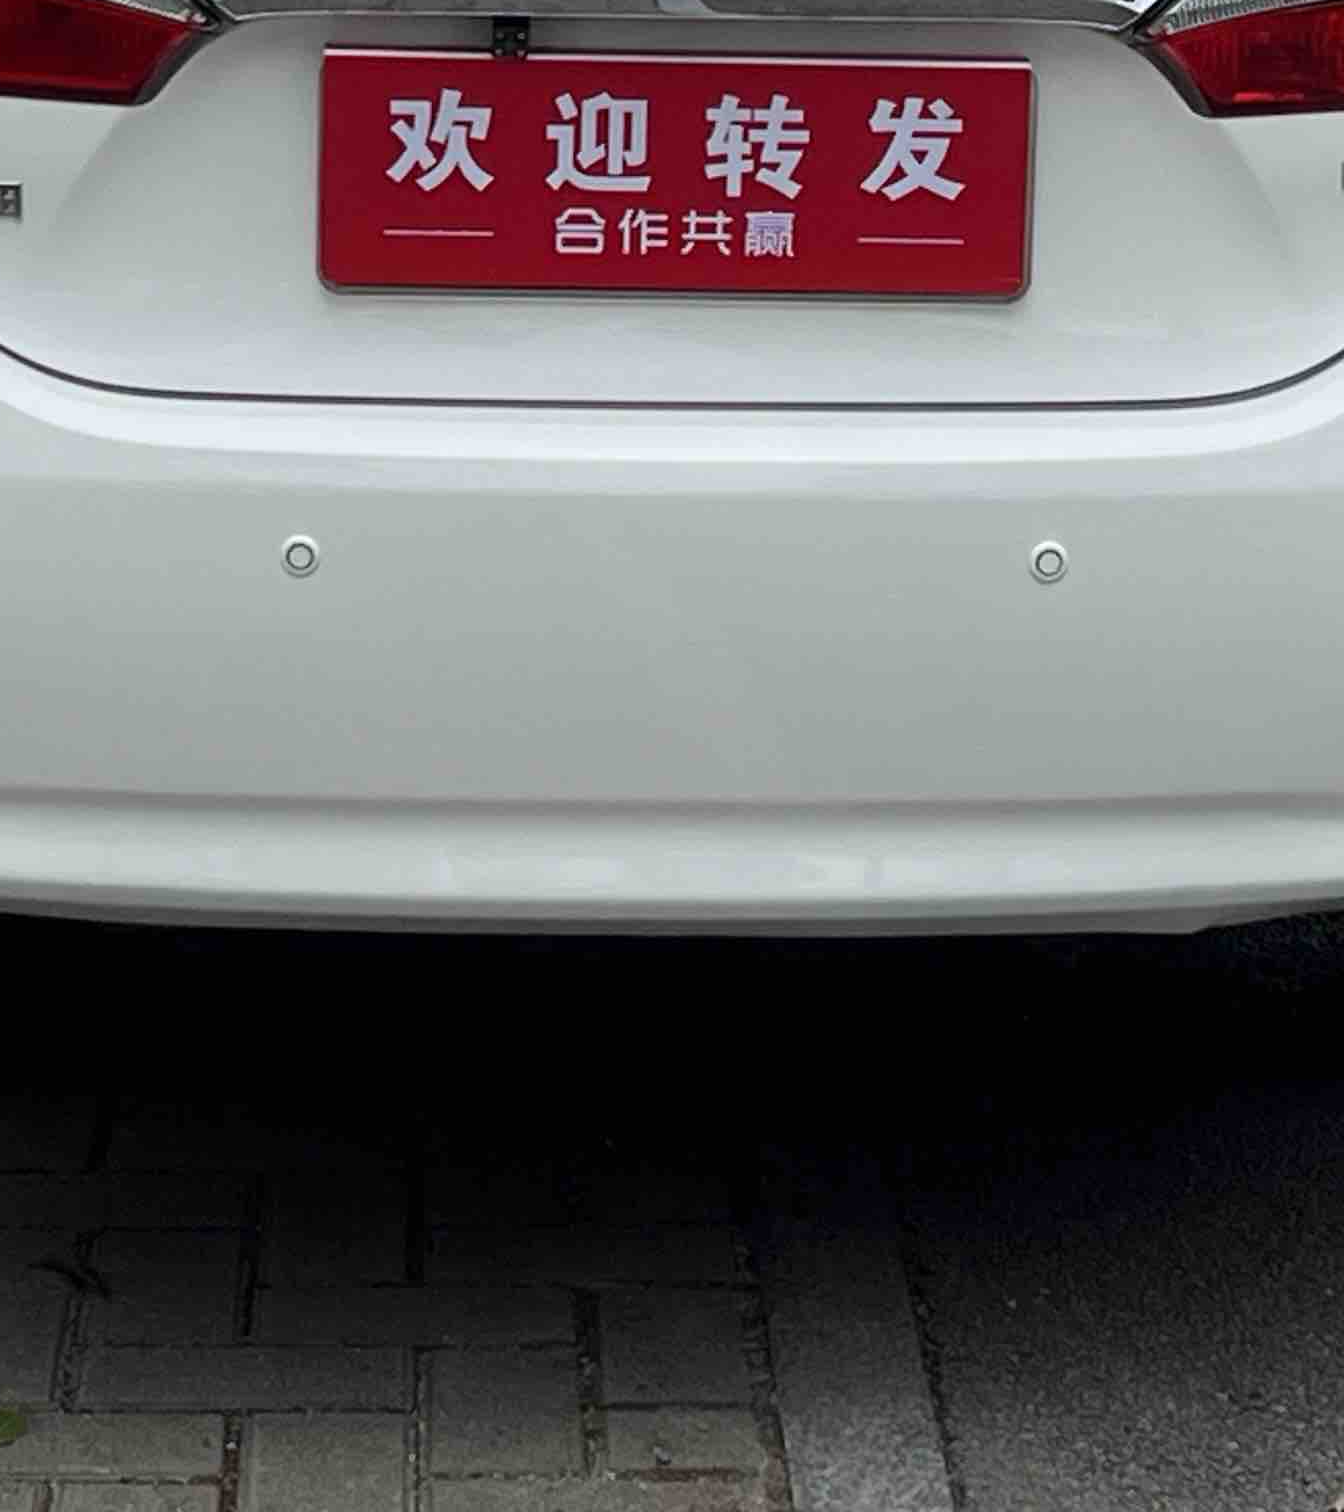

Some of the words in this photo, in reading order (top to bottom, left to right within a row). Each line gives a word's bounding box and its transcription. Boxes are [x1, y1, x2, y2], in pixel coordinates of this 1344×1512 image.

[385, 88, 966, 202] 欢迎转发
[554, 207, 796, 258] 合作共赢
